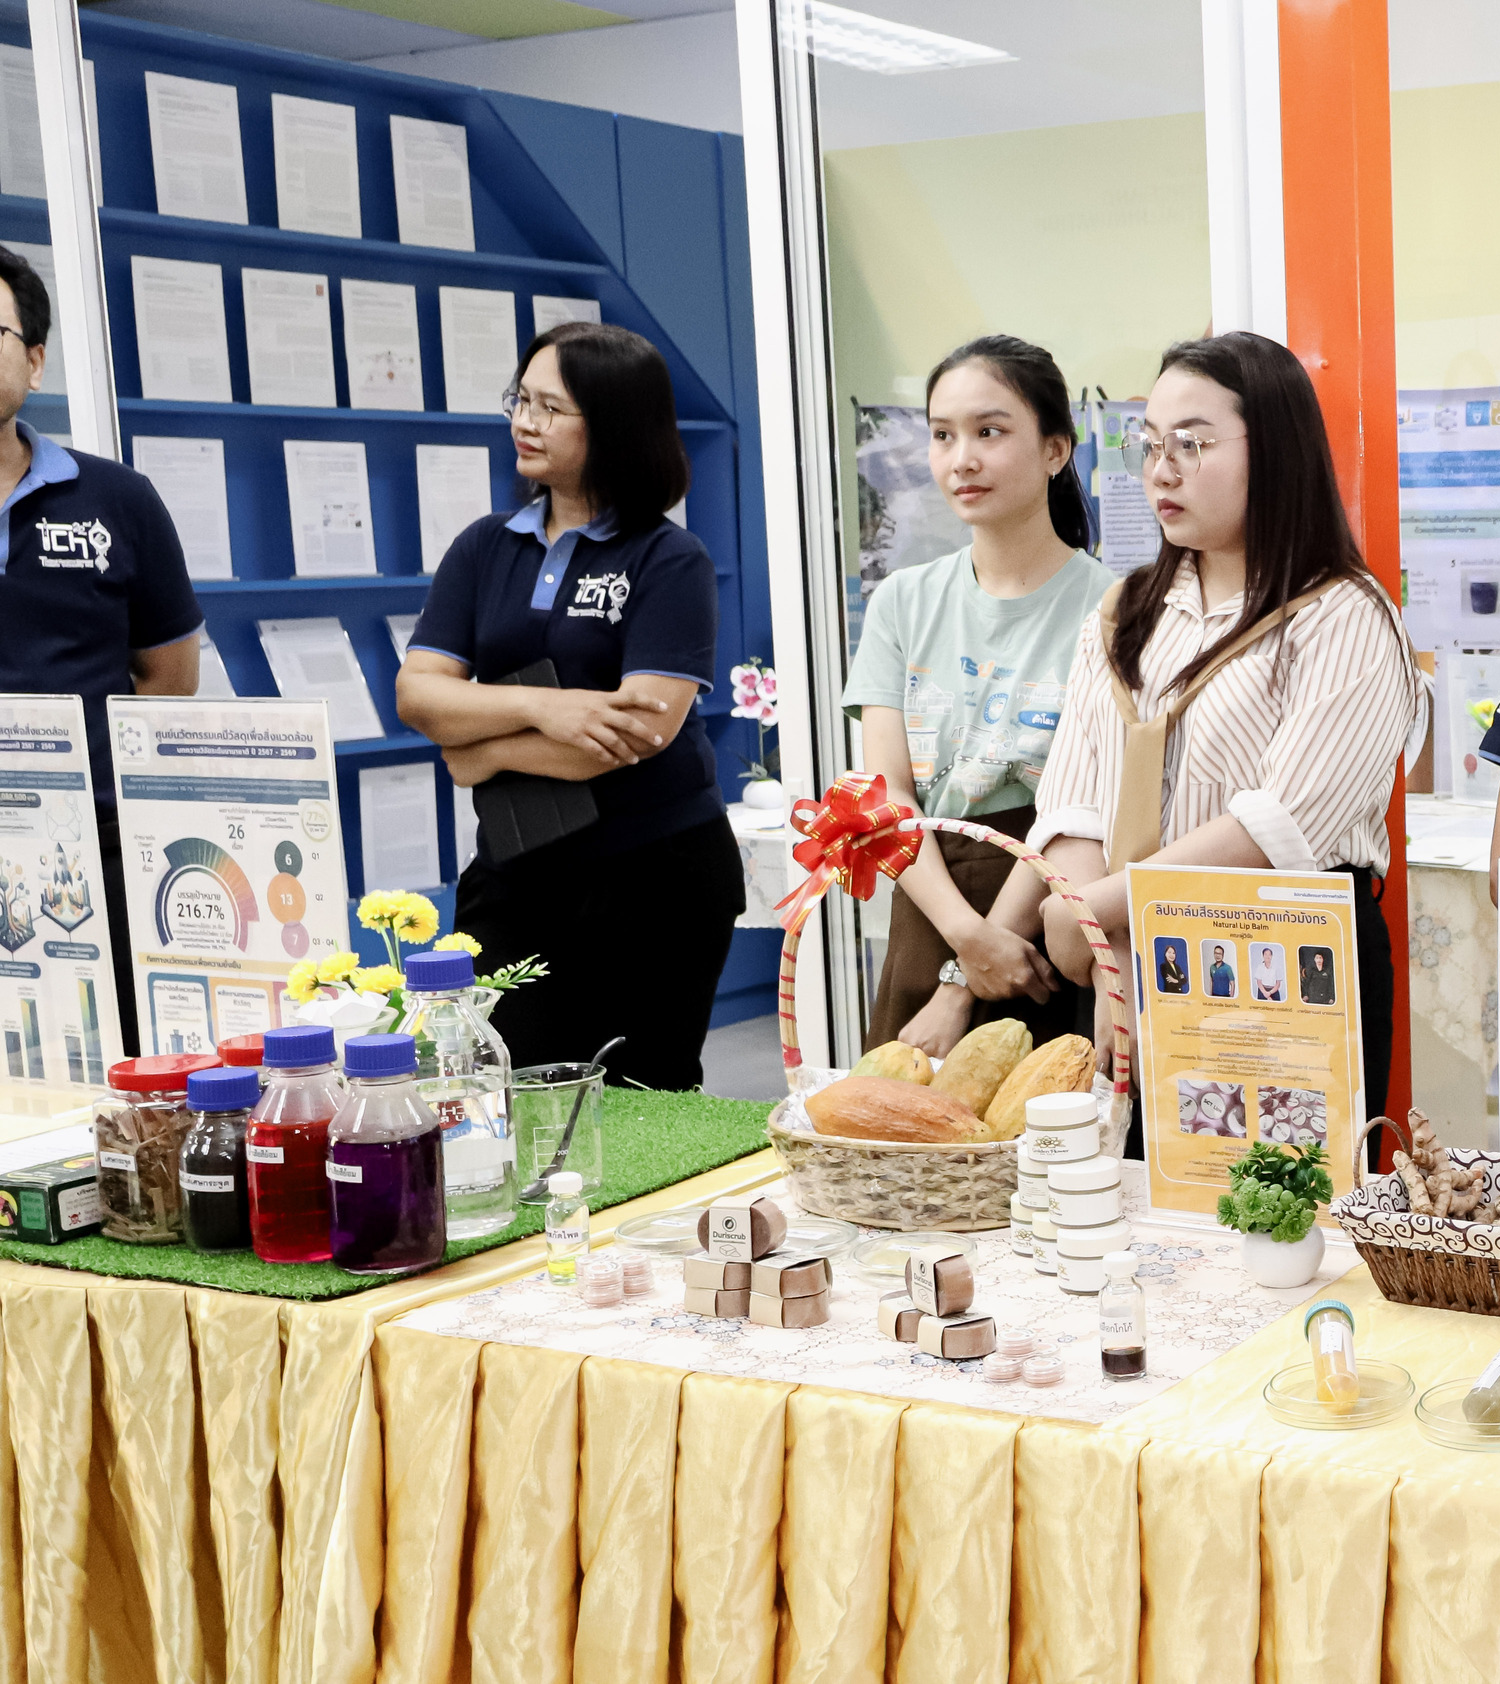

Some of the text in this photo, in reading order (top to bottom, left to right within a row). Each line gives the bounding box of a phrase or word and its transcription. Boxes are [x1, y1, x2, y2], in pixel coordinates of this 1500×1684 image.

[228, 824, 245, 840] 26
[140, 850, 153, 863] 12
[284, 854, 292, 866] 6
[280, 893, 294, 905] 13
[177, 903, 225, 920] 216.7%
[1155, 903, 1327, 925] ลิปบาล์มสีธรรมชาติจากแก้วมังกร
[1213, 921, 1269, 932] Natural Lip Balm
[713, 1231, 746, 1240] Duriscrub
